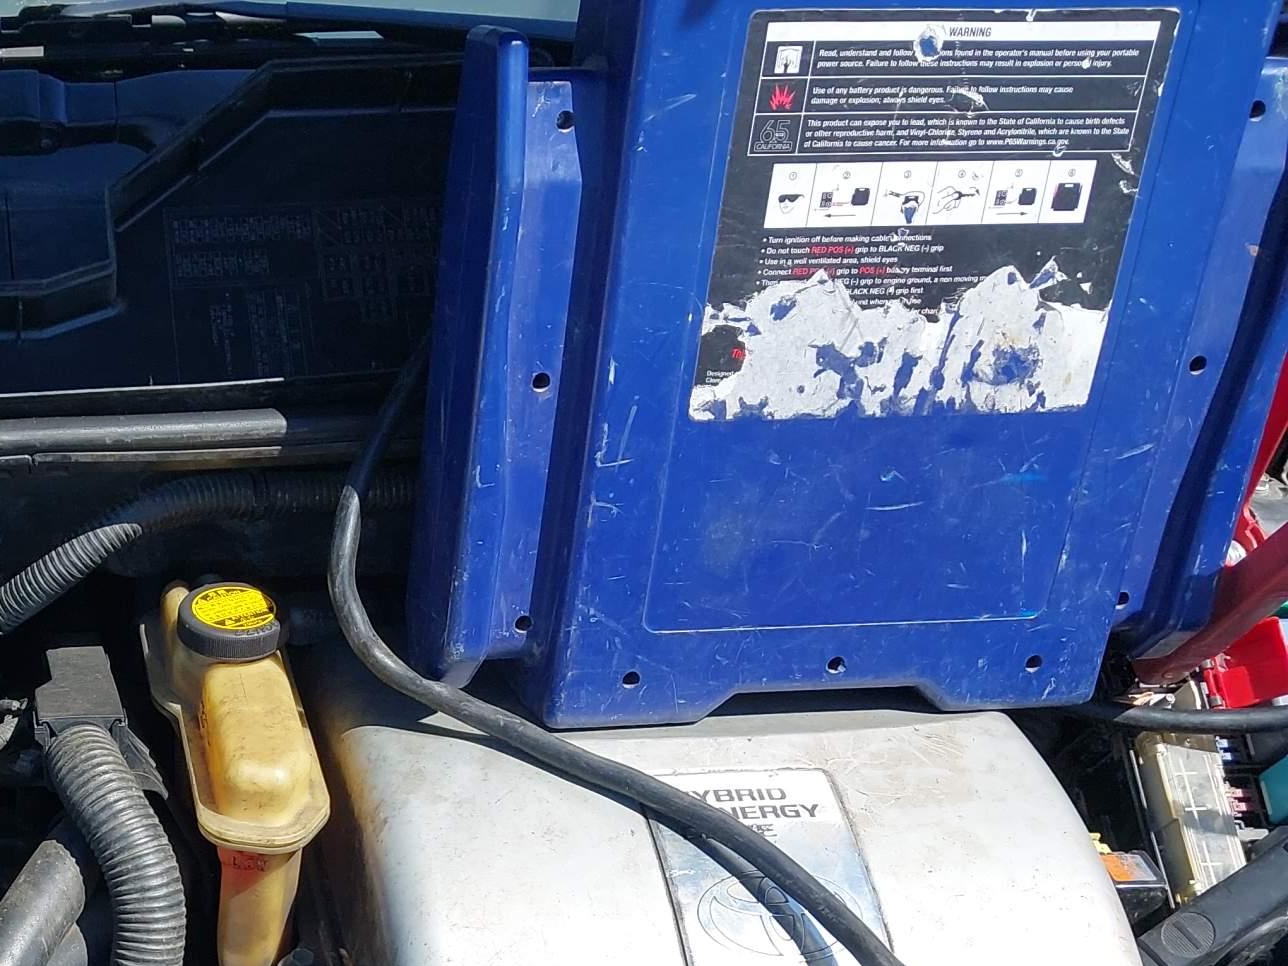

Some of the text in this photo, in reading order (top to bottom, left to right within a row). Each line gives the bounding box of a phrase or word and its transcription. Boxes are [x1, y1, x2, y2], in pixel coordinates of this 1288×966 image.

[949, 27, 991, 37] WARNING
[819, 50, 837, 58] Read,
[995, 49, 1027, 57] operator's
[1077, 49, 1095, 57] using
[1112, 49, 1139, 57] portable
[850, 87, 872, 95] battery
[874, 87, 899, 95] product
[811, 97, 837, 105] damage
[883, 97, 906, 105] always
[910, 119, 926, 127] lead,
[760, 119, 791, 142] 65
[833, 130, 875, 138] reproductive
[958, 129, 982, 137] Styrene
[855, 246, 868, 254] grip
[931, 245, 944, 253] grip
[860, 278, 873, 286] grip
[907, 277, 932, 285] ground,
[954, 276, 979, 284] moving
[896, 287, 908, 295] grip
